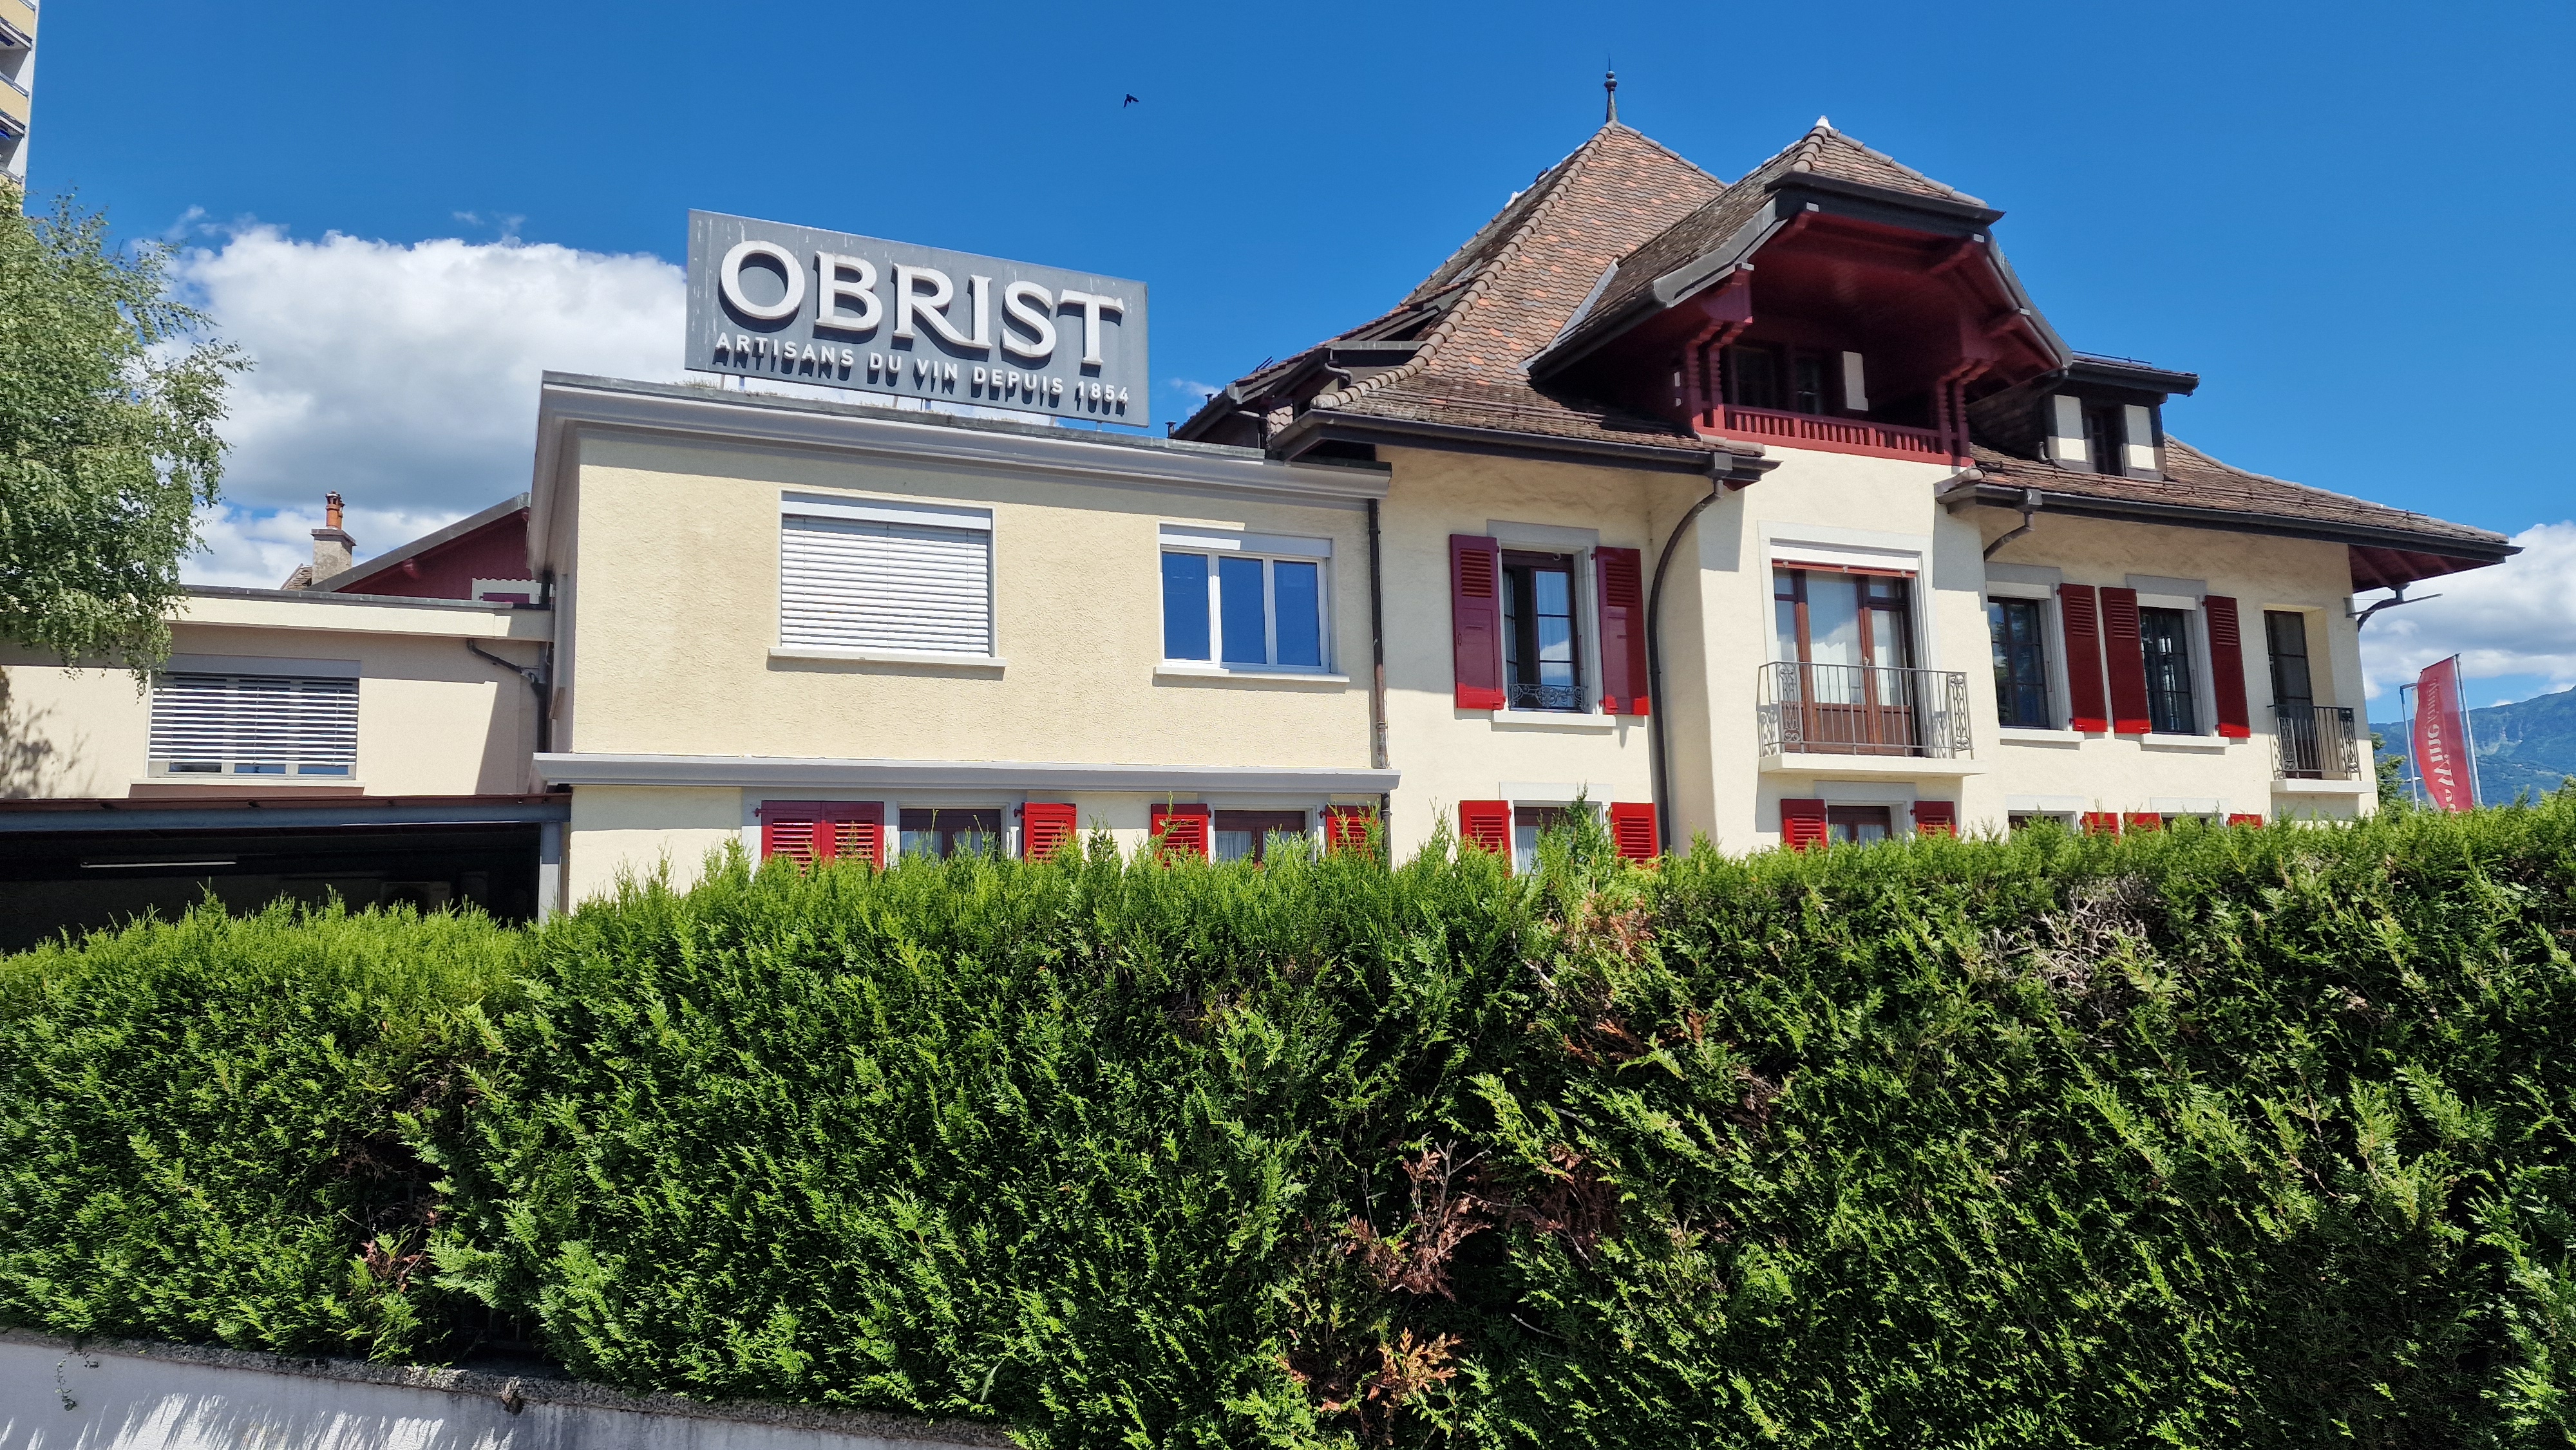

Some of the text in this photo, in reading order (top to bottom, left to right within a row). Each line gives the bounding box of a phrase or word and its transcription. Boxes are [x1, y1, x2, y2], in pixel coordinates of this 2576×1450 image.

[719, 240, 1125, 367] OBRIST
[715, 332, 1130, 404] ARTISANS DU VIN DEPUIS 1854
